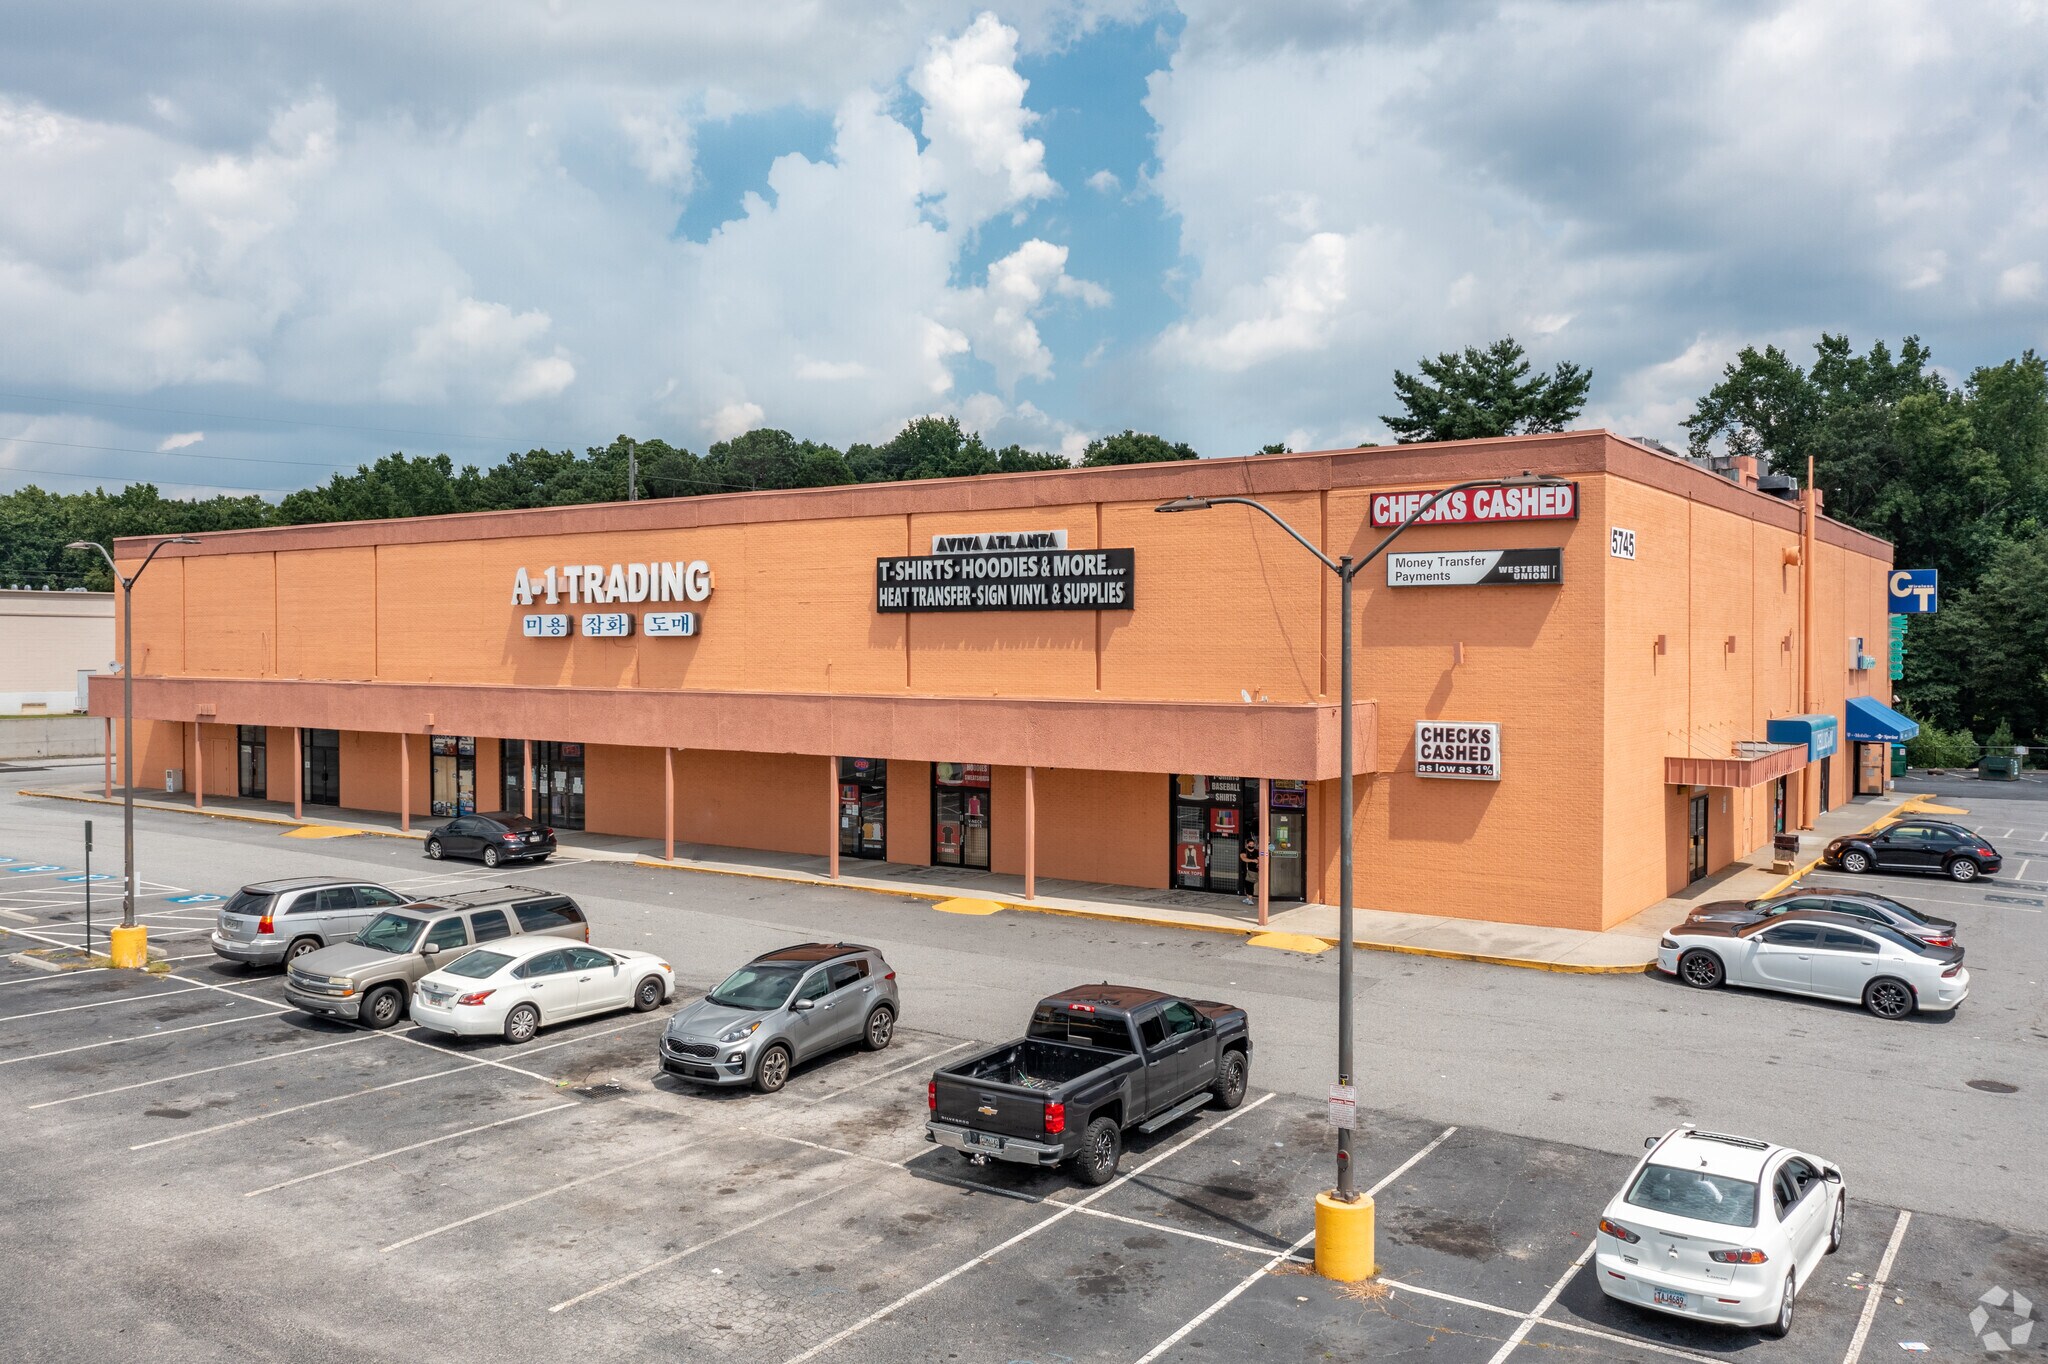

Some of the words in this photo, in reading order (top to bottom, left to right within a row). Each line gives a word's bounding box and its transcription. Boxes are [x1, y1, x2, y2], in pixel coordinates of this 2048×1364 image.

[1374, 491, 1467, 524] CHECKS
[1473, 486, 1573, 518] CASHED
[936, 536, 982, 552] AVIVA
[985, 532, 1058, 550] ATLANTA
[1611, 529, 1635, 557] 5745
[961, 556, 1038, 579] HOODIES
[1041, 557, 1050, 577] &
[1053, 554, 1126, 576] MORE...
[1395, 557, 1434, 569] Money
[1437, 556, 1486, 567] Transfer
[1499, 565, 1548, 573] WESTERN
[563, 560, 712, 604] TRADING
[1395, 572, 1450, 582] Payments
[879, 587, 910, 606] HEAT
[1010, 584, 1048, 605] VINYL
[1052, 584, 1061, 604] &
[1064, 582, 1125, 604] SUPPLIES
[526, 616, 565, 635] 미용
[585, 615, 626, 635] 잡화
[649, 614, 690, 633] 도매
[1890, 614, 1908, 680] Wireless
[1421, 727, 1491, 744] CHECKS
[1421, 744, 1491, 761] CASHED
[1419, 764, 1432, 772] as
[1435, 764, 1455, 772] low
[1475, 766, 1493, 775] 1%
[1211, 782, 1240, 791] BASEBALL
[1215, 793, 1236, 801] SHIRTS
[1273, 793, 1303, 805] OPEN
